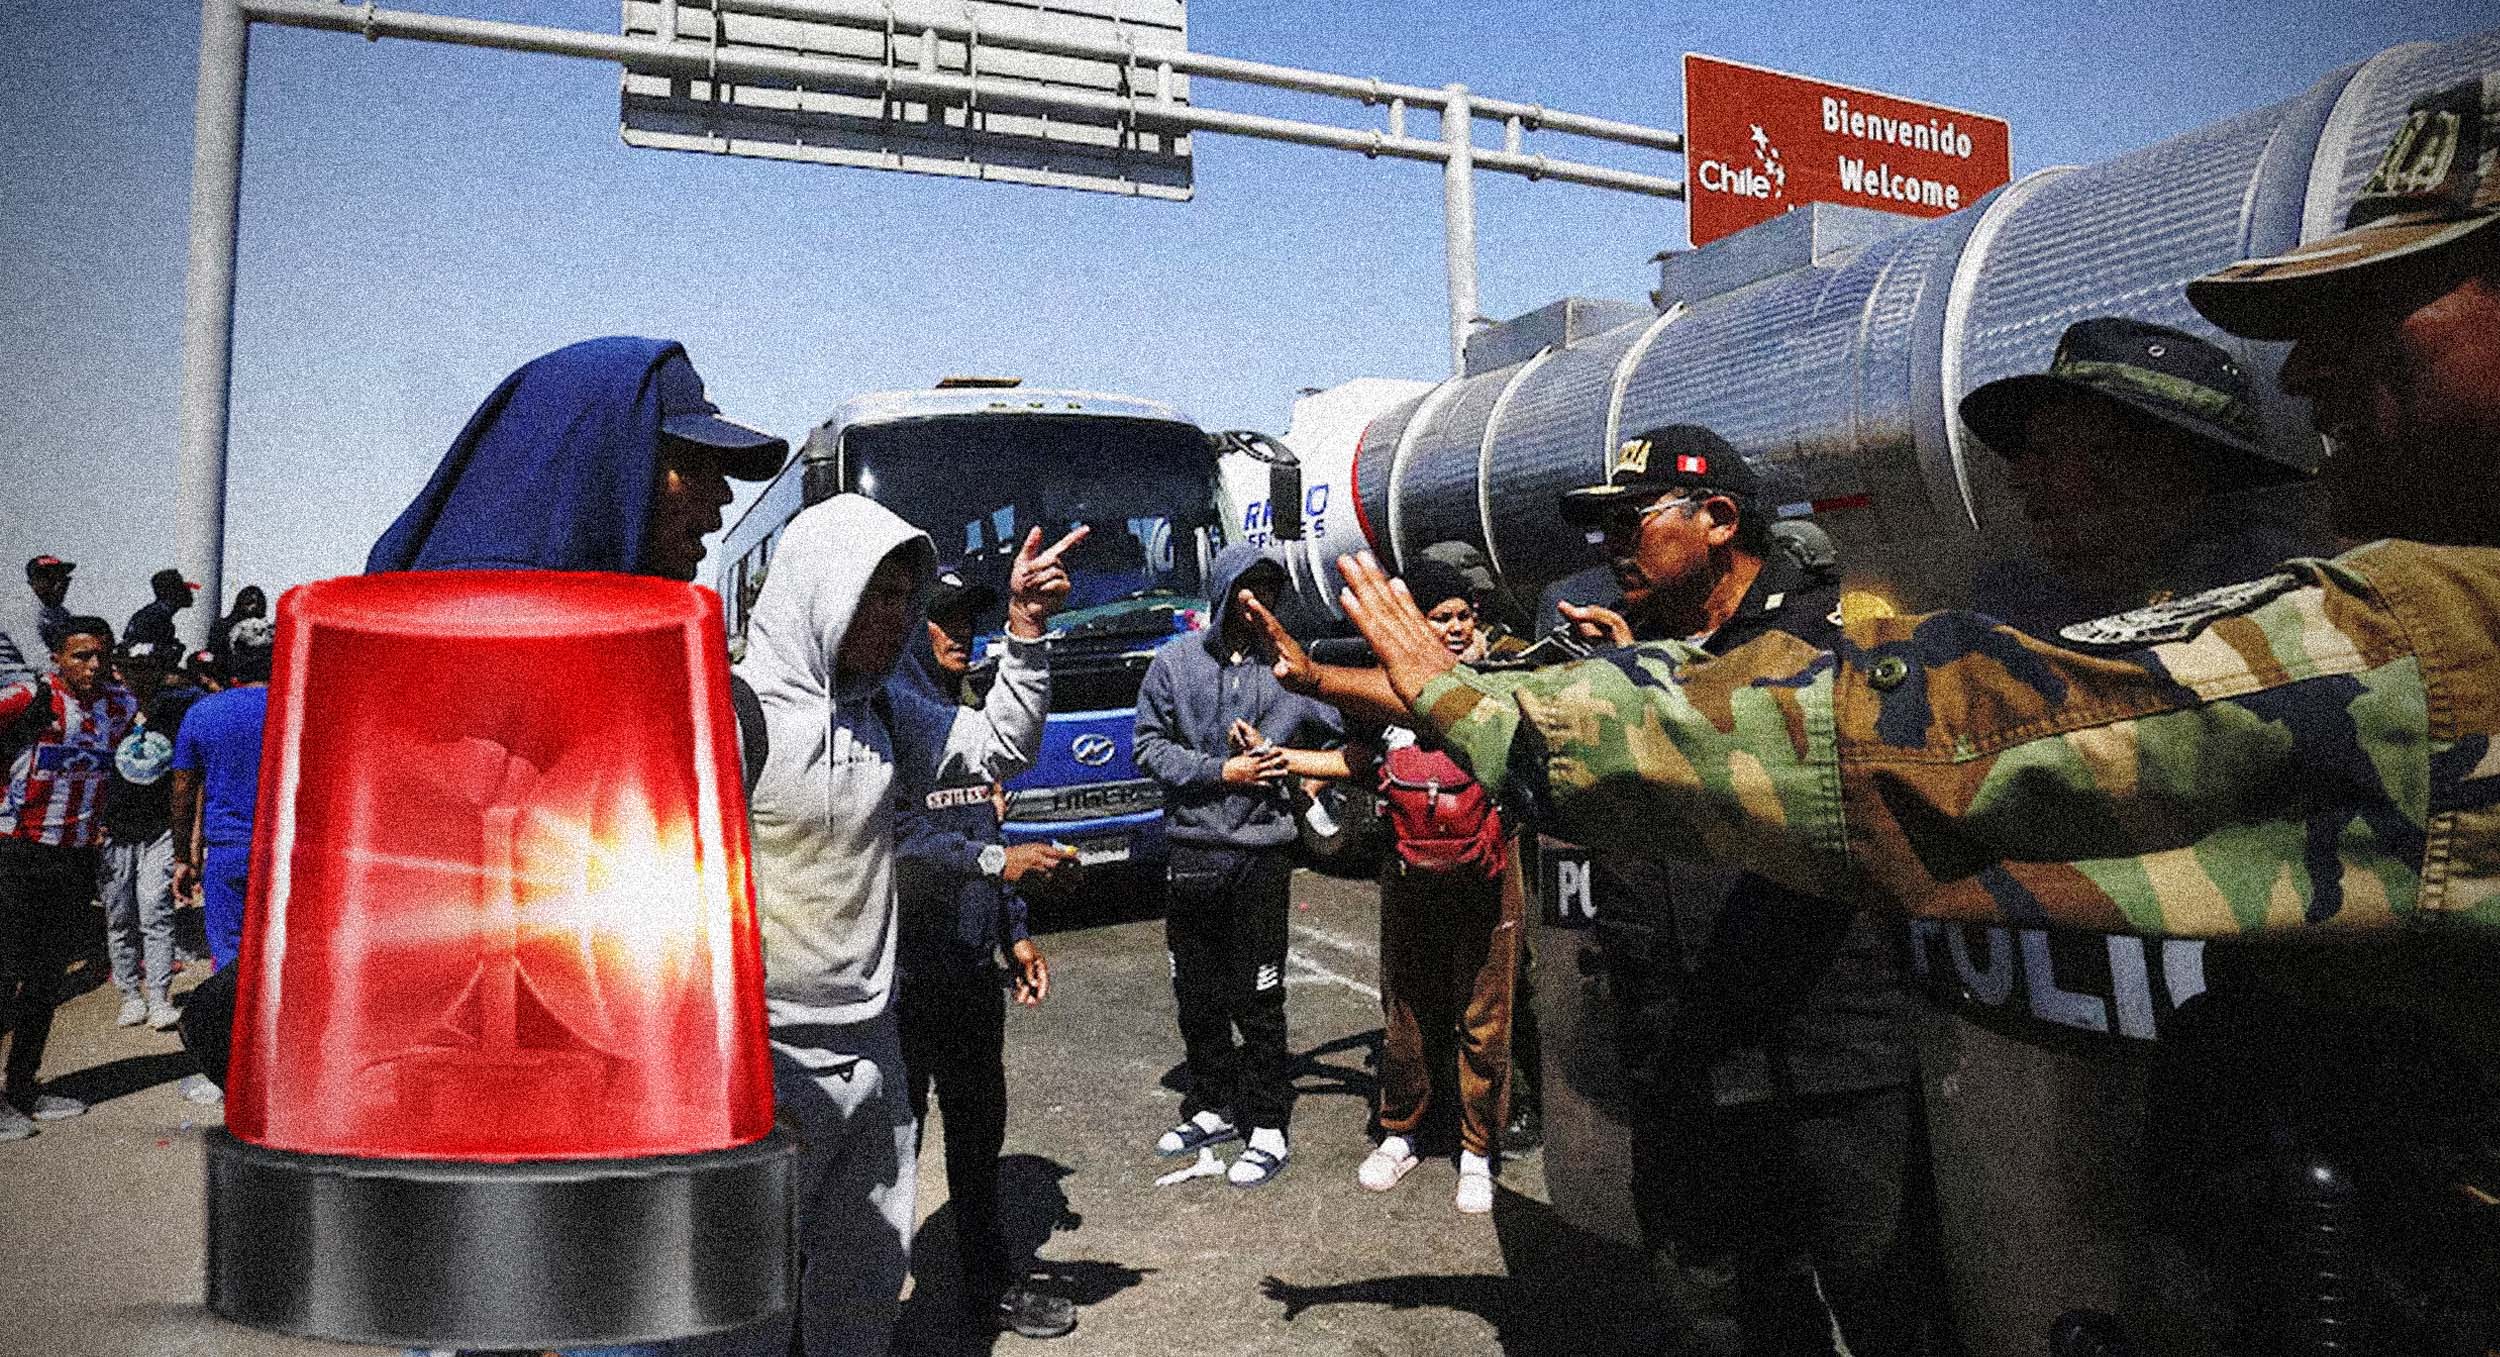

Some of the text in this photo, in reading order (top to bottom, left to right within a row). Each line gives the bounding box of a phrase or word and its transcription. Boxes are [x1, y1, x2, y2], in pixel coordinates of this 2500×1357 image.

[1821, 95, 1972, 160] Bienvenido
[1698, 160, 1770, 199] Chile
[1837, 155, 1960, 210] Welcome
